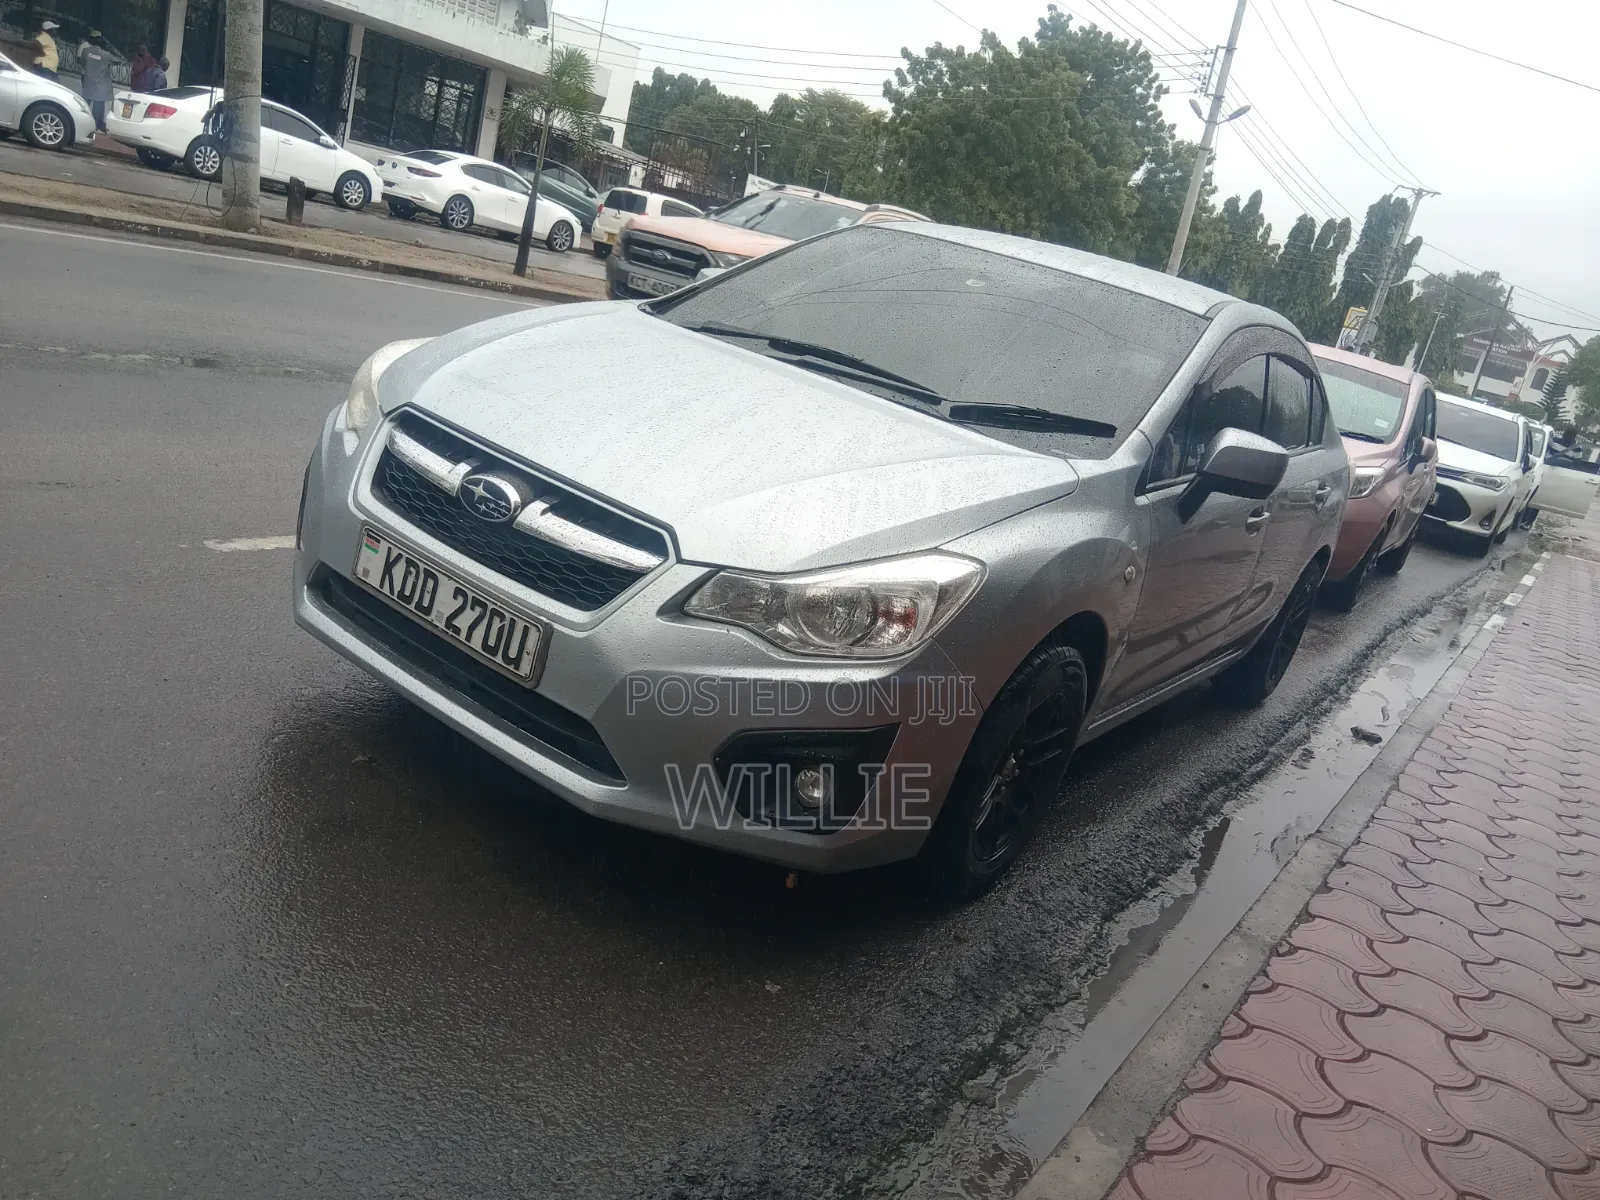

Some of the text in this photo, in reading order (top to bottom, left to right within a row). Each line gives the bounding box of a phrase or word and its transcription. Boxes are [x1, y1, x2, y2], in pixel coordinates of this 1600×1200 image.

[1486, 346, 1508, 354] SATION
[1500, 344, 1521, 353] RAILWAY
[379, 545, 530, 671] KDD 270U
